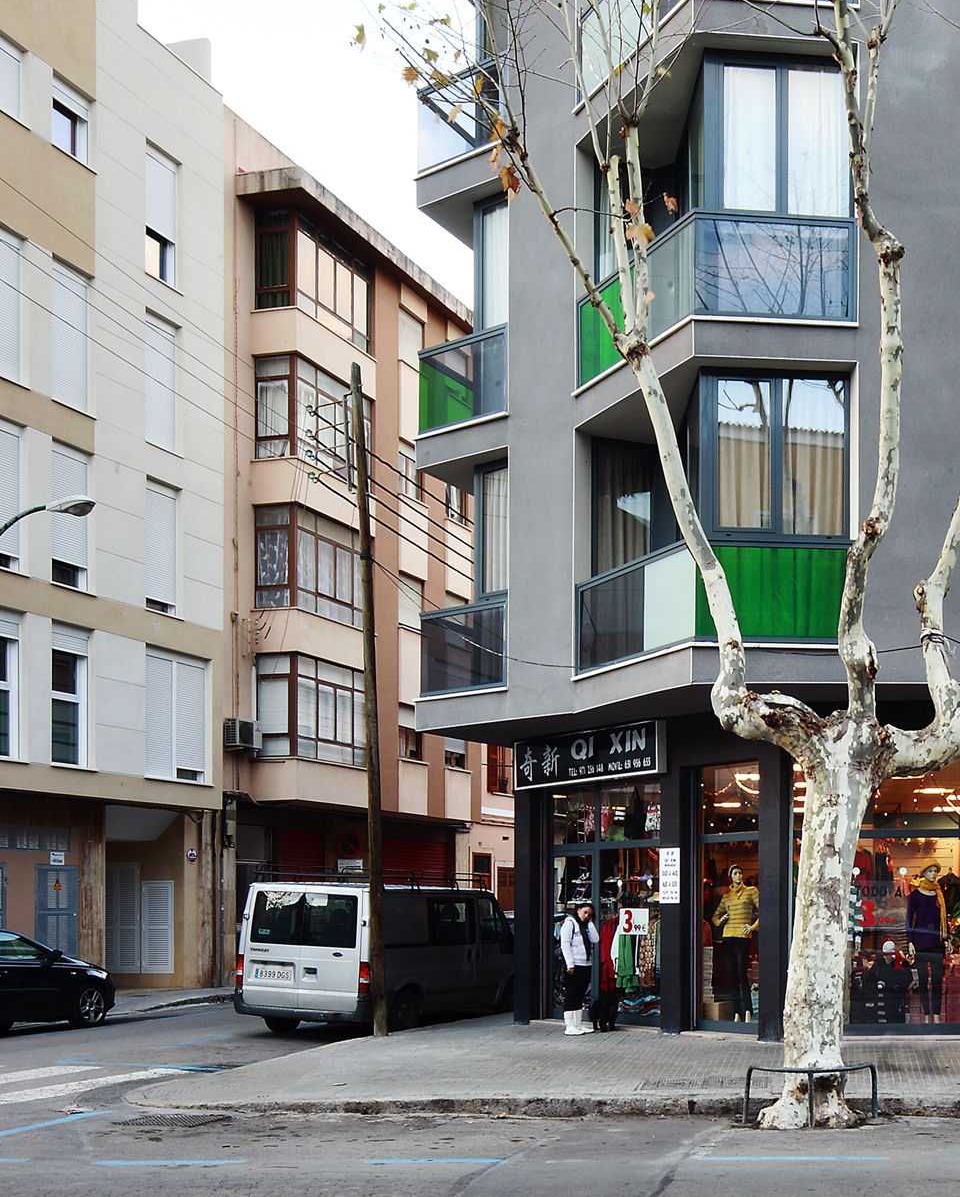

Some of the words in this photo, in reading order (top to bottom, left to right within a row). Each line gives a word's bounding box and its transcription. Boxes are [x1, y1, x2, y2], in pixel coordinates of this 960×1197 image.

[570, 735, 594, 761] QI
[609, 727, 646, 754] XIN
[520, 745, 560, 782] 奇新
[259, 970, 276, 979] 8399
[277, 971, 290, 980] DGS
